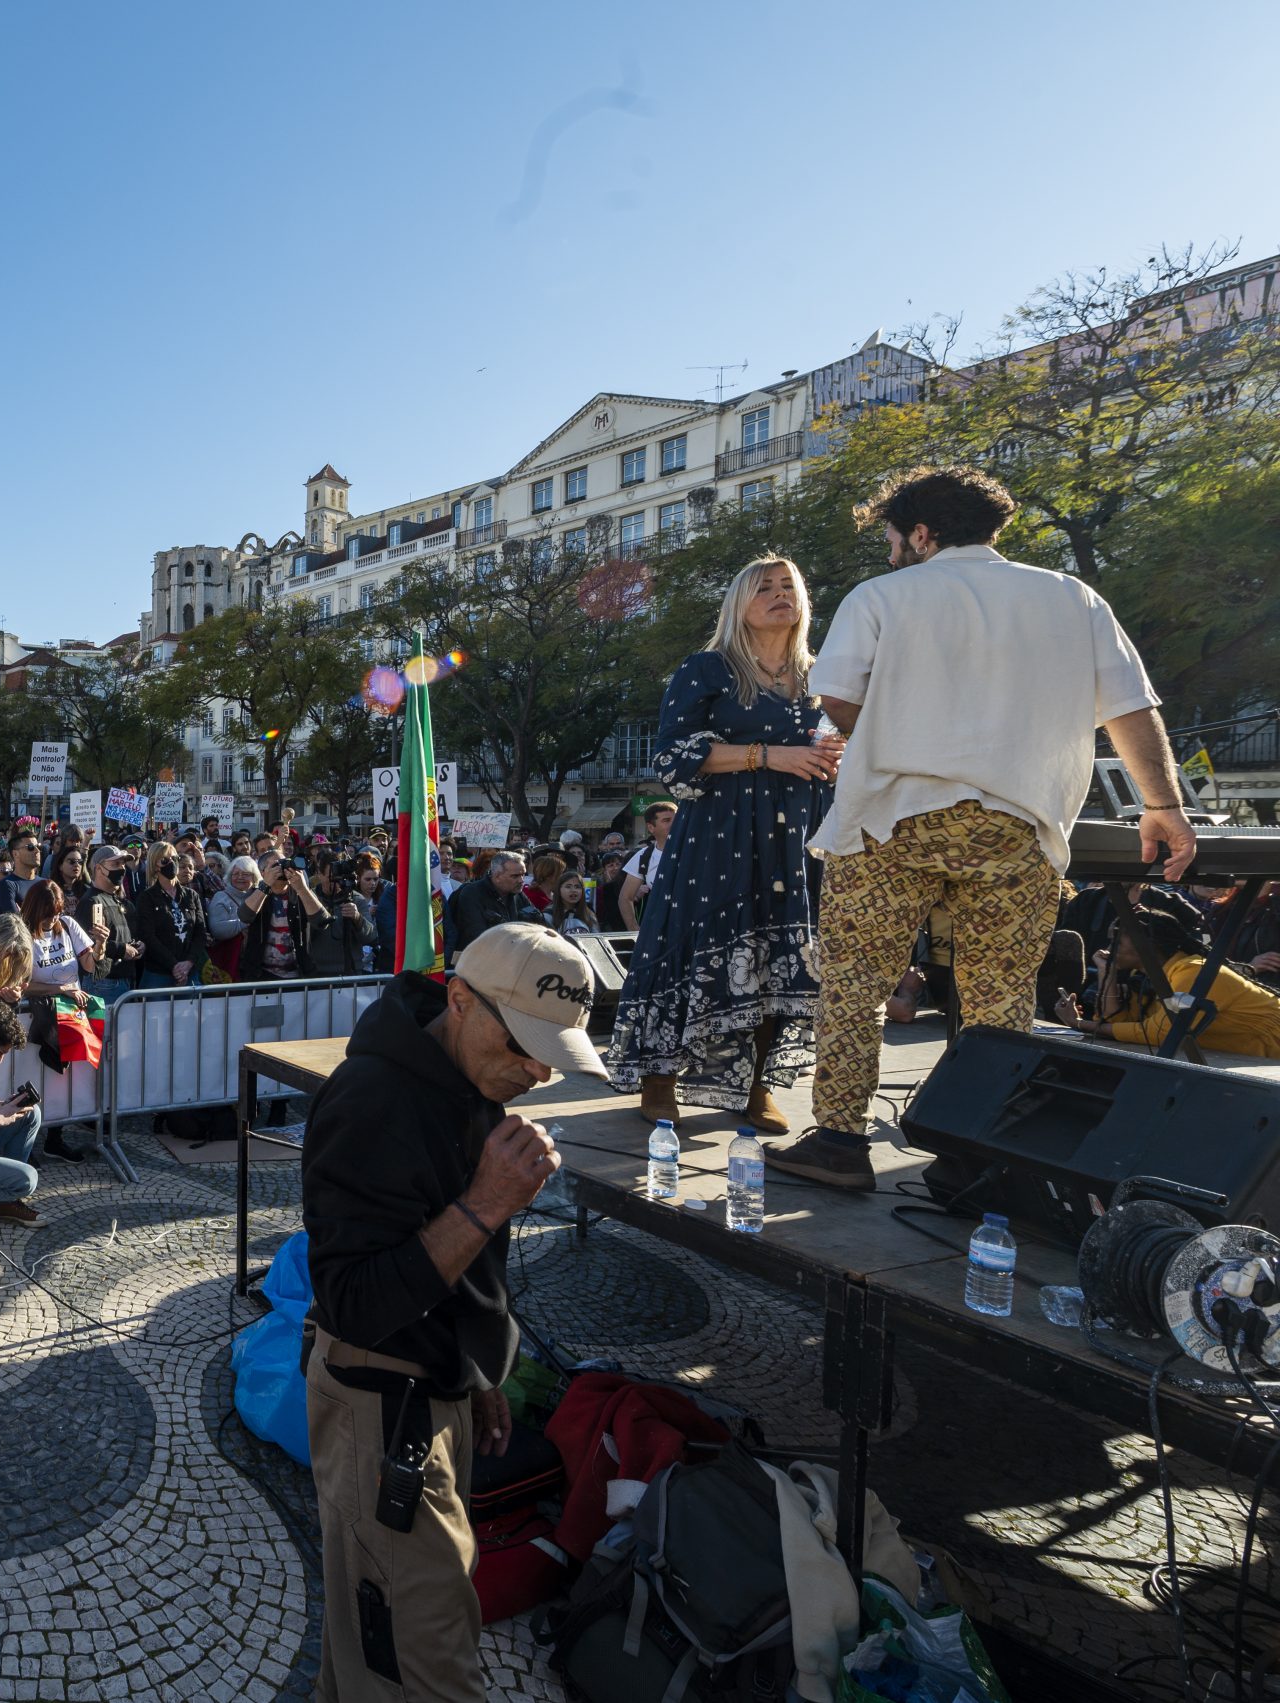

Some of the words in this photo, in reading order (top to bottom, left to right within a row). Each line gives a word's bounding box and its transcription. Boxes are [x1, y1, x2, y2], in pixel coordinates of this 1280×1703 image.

[41, 745, 59, 753] Mais
[32, 755, 66, 763] controlo?
[40, 764, 55, 772] Não
[31, 774, 63, 783] Obrigado
[111, 789, 135, 801] COSTA
[109, 797, 142, 812] MARCELO
[43, 942, 65, 954] PELA
